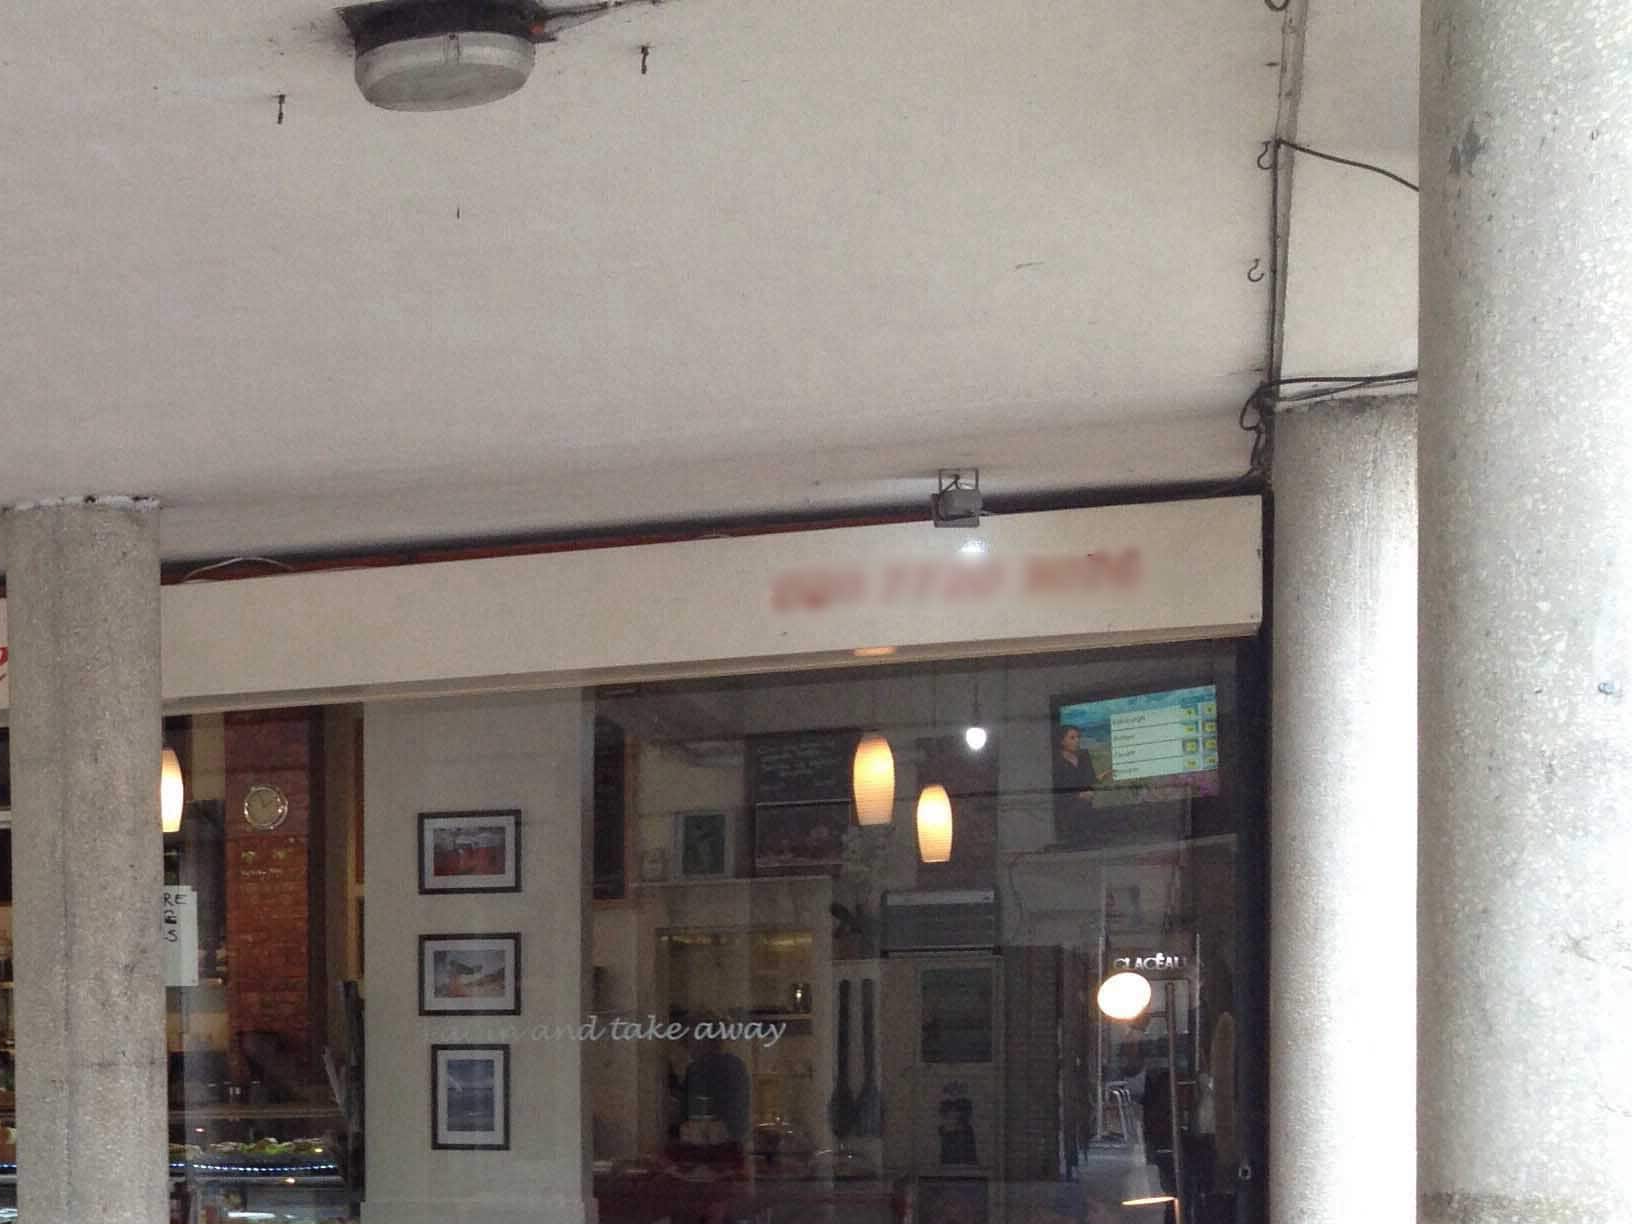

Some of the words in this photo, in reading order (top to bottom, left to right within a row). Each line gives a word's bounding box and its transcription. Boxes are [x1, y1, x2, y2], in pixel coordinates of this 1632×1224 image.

[530, 1014, 606, 1041] and
[610, 1016, 689, 1041] take
[694, 1021, 786, 1048] away
